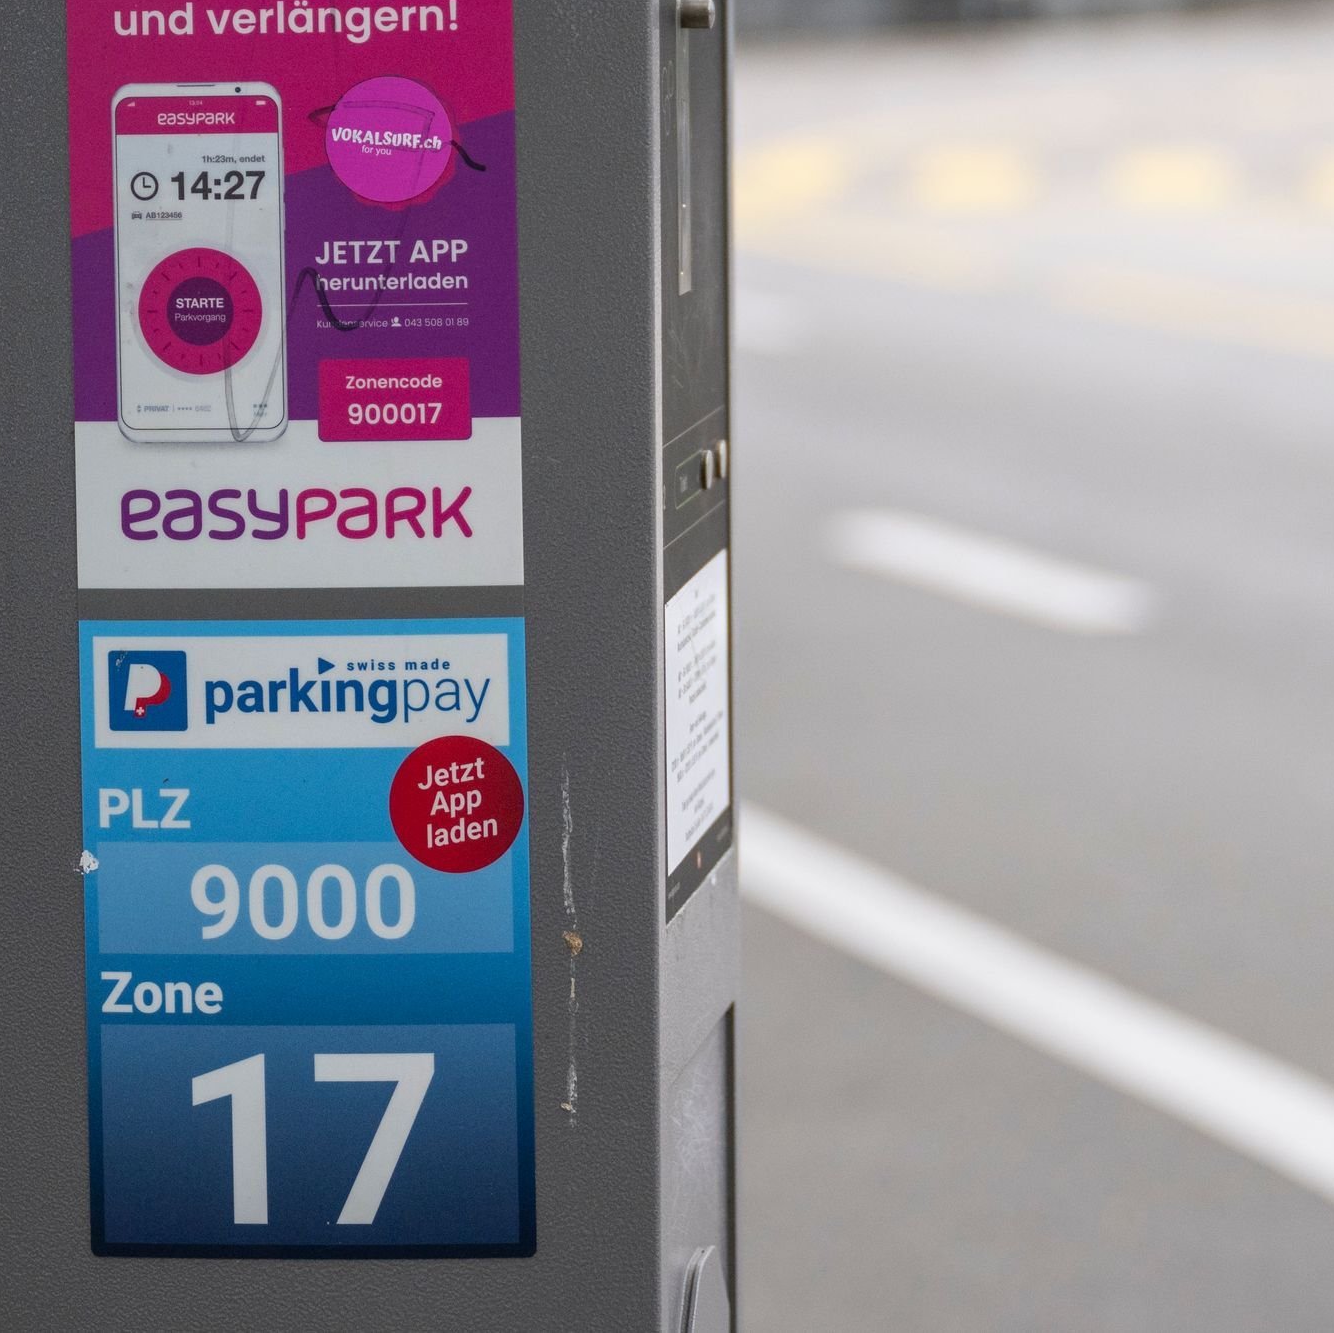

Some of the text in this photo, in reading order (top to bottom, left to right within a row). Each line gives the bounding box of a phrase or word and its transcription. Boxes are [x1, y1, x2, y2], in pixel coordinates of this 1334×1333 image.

[113, 0, 459, 44] und verlängern!
[331, 126, 442, 150] VOKALSURF.ch
[361, 145, 392, 156] for you
[239, 155, 265, 163] endet
[170, 170, 265, 200] 14:27
[315, 239, 468, 264] JETZT APP
[316, 272, 468, 291] herunterladen
[175, 297, 224, 309] STARTE
[174, 312, 226, 322] Parkvorgang
[404, 318, 422, 327] 043
[425, 318, 443, 327] 508
[445, 318, 455, 326] 01
[457, 317, 469, 326] 89
[346, 374, 442, 390] Zonencode
[347, 403, 442, 425] 900017
[347, 658, 450, 671] swiss made
[205, 667, 490, 724] parkingpay
[418, 756, 485, 791] Jetzt
[99, 787, 191, 829] PLZ
[430, 788, 482, 818] App
[426, 815, 498, 848] laden
[191, 863, 416, 940] 9000
[101, 970, 223, 1014] Zone
[192, 1052, 435, 1225] 17
